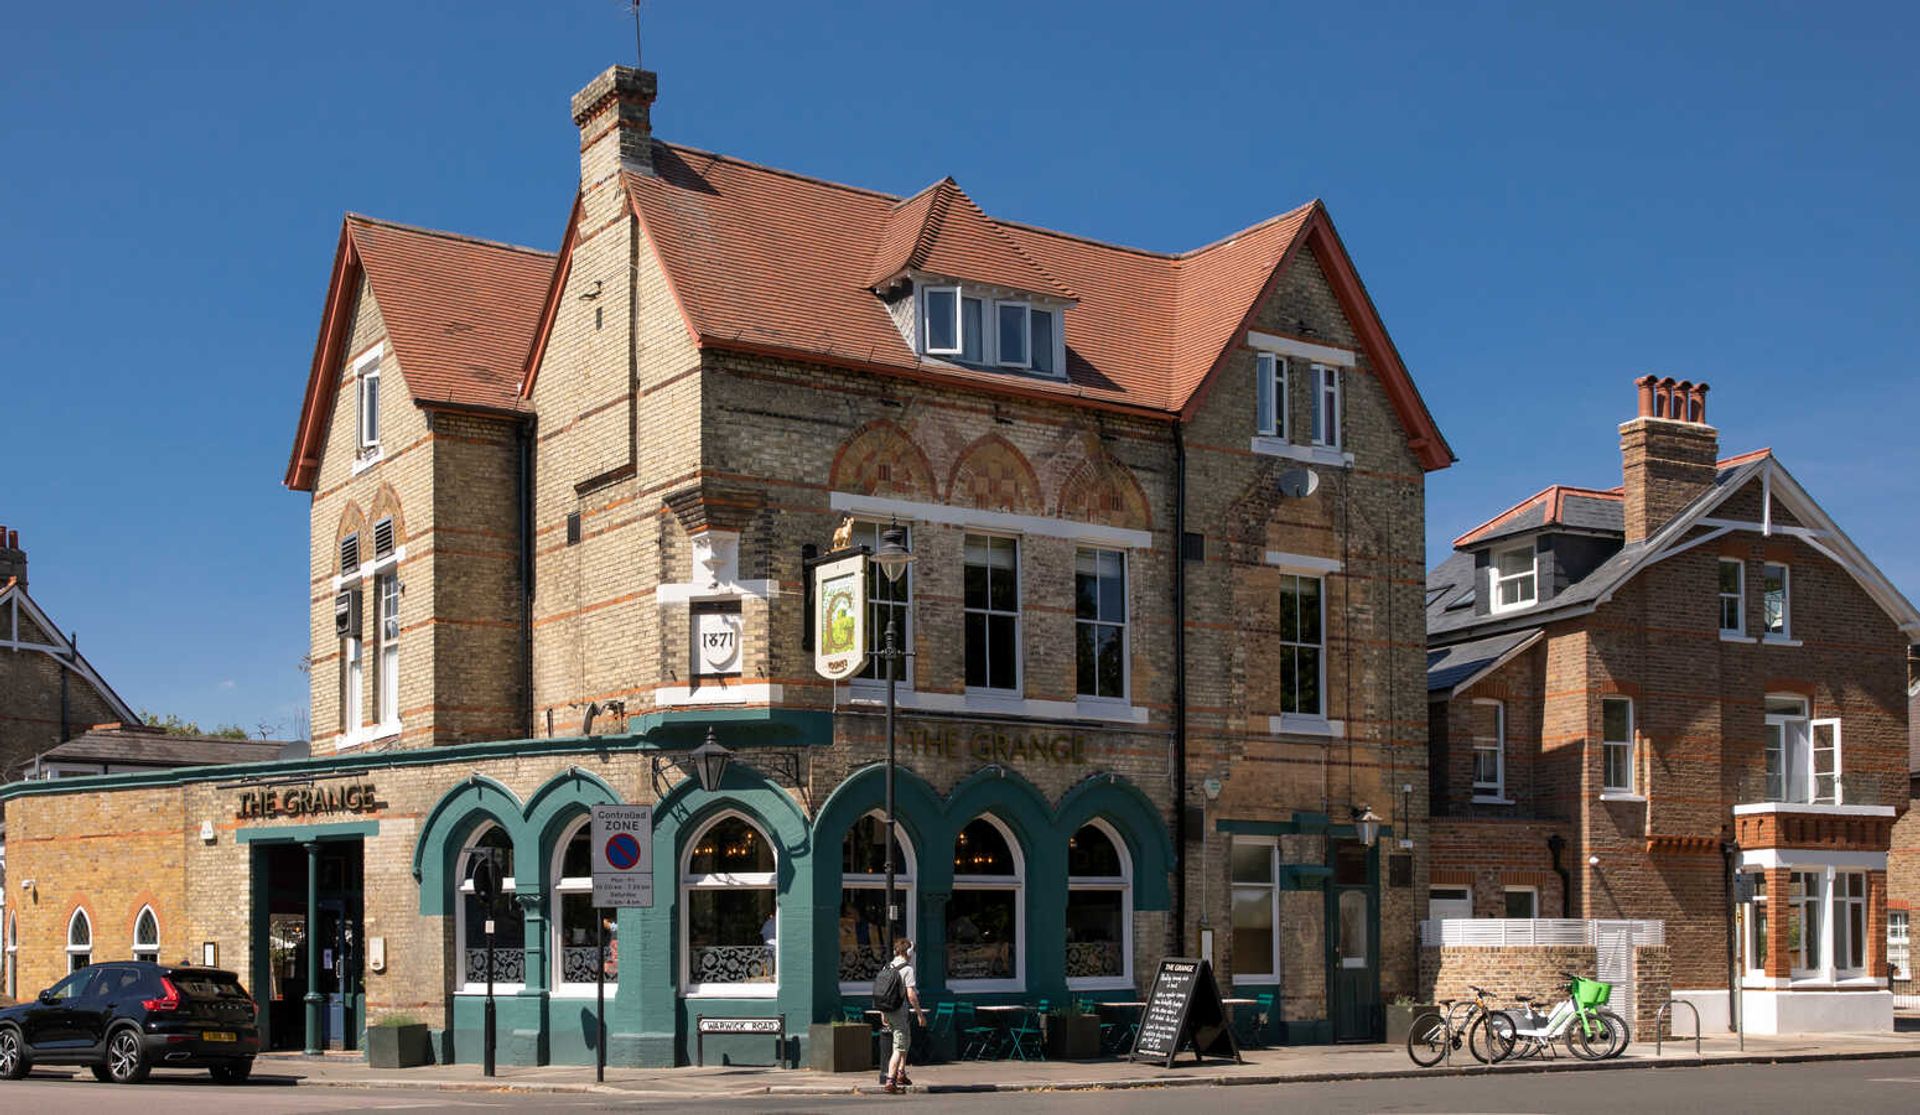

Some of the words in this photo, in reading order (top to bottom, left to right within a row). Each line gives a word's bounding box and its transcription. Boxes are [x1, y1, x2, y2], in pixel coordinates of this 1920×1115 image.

[703, 632, 733, 648] 1871
[909, 729, 957, 758] THE
[971, 732, 1086, 765] GRANGE
[239, 790, 277, 817] THE
[283, 784, 376, 815] GRANGE
[598, 811, 647, 820] Controlled
[605, 821, 640, 831] ZONE
[707, 1021, 746, 1030] WARWICK
[752, 1021, 775, 1030] ROAD
